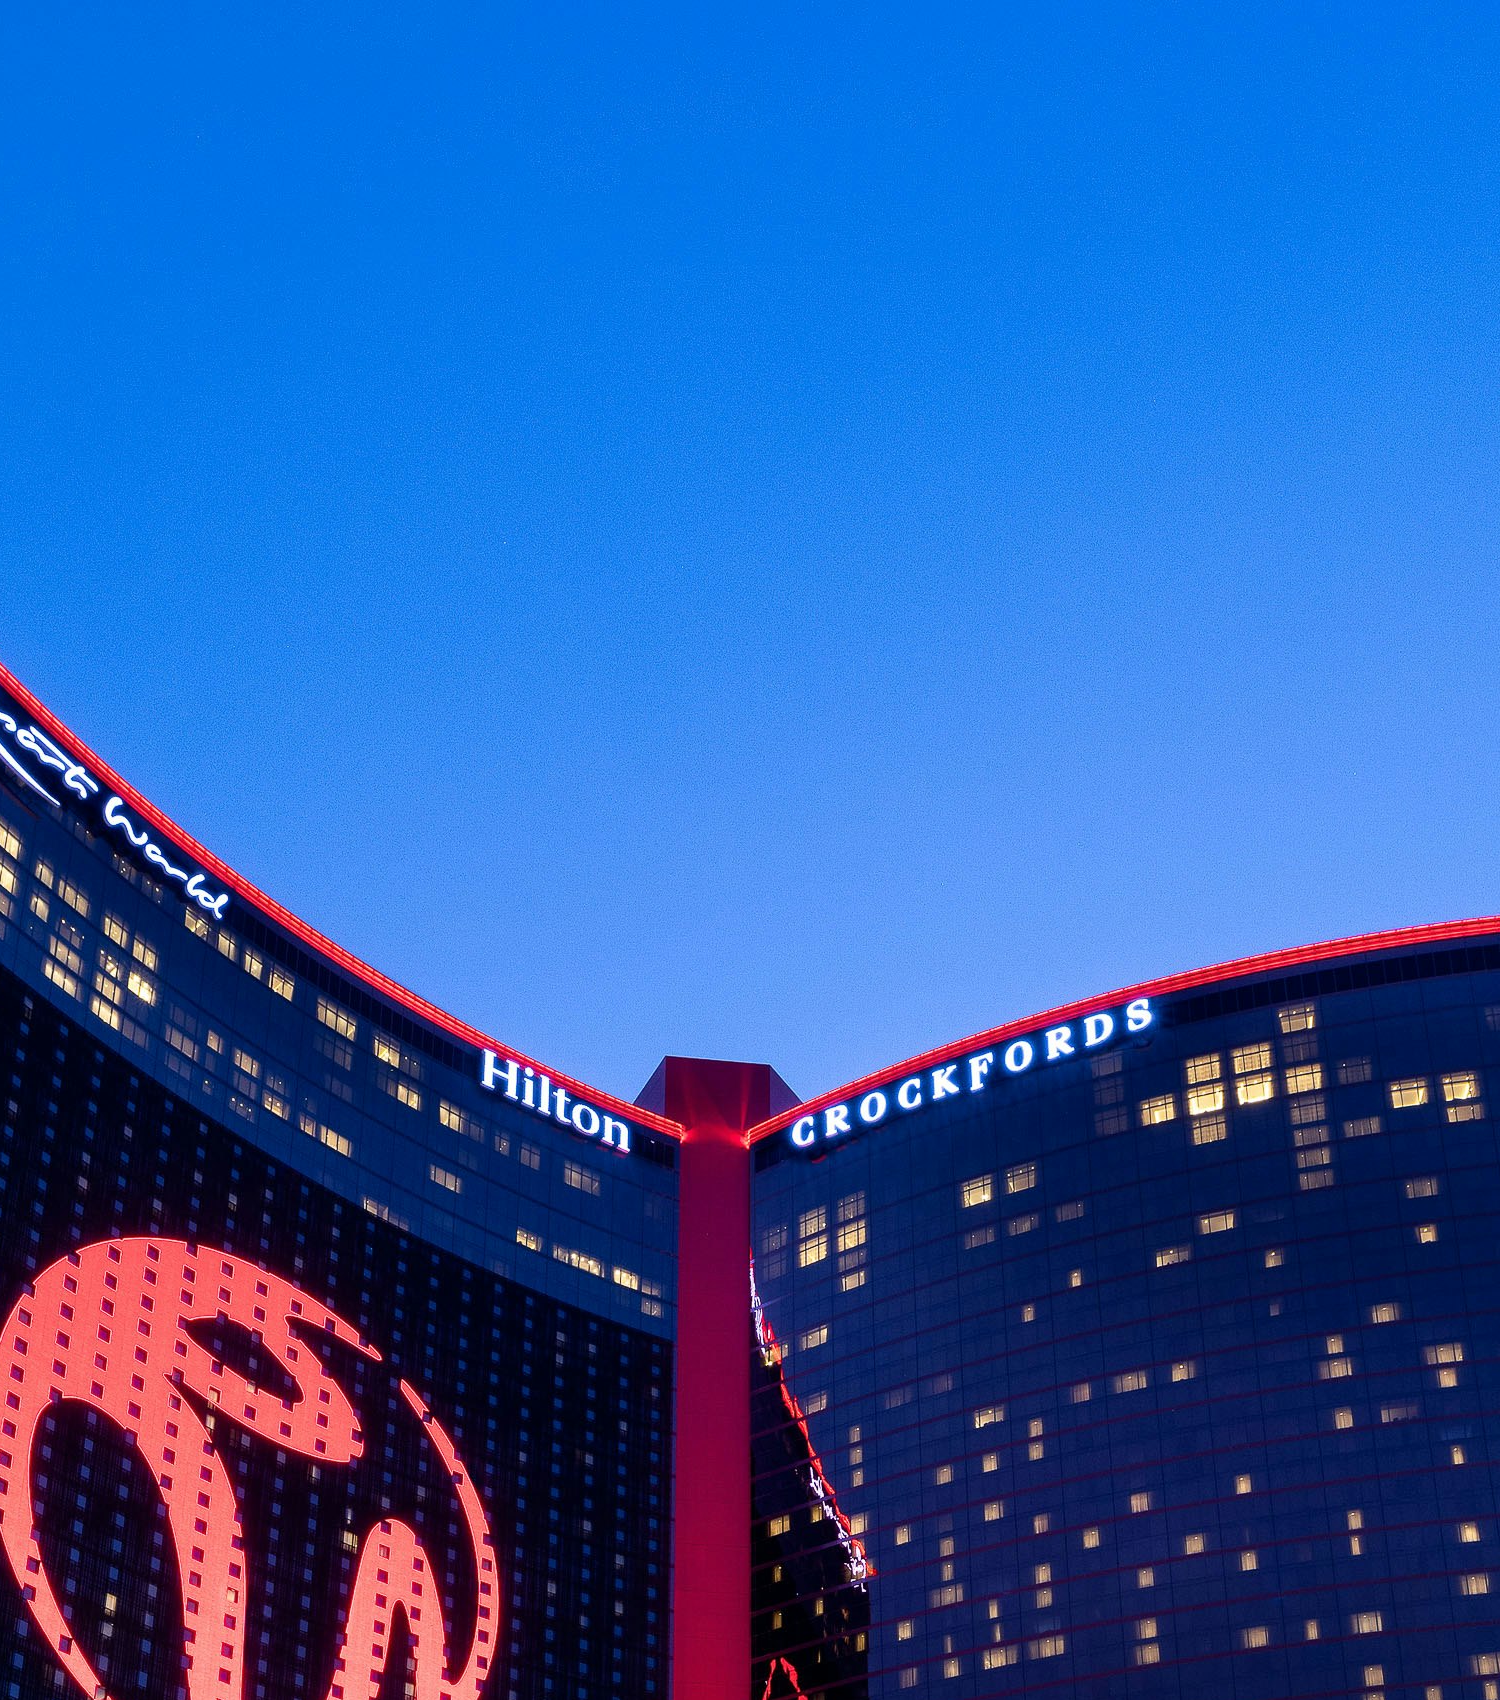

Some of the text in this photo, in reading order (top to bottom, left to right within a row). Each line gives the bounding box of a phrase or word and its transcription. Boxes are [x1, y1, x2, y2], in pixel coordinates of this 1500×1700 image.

[104, 796, 229, 919] World
[480, 1048, 631, 1154] Hilton
[791, 998, 1153, 1147] CROCKFORDS
